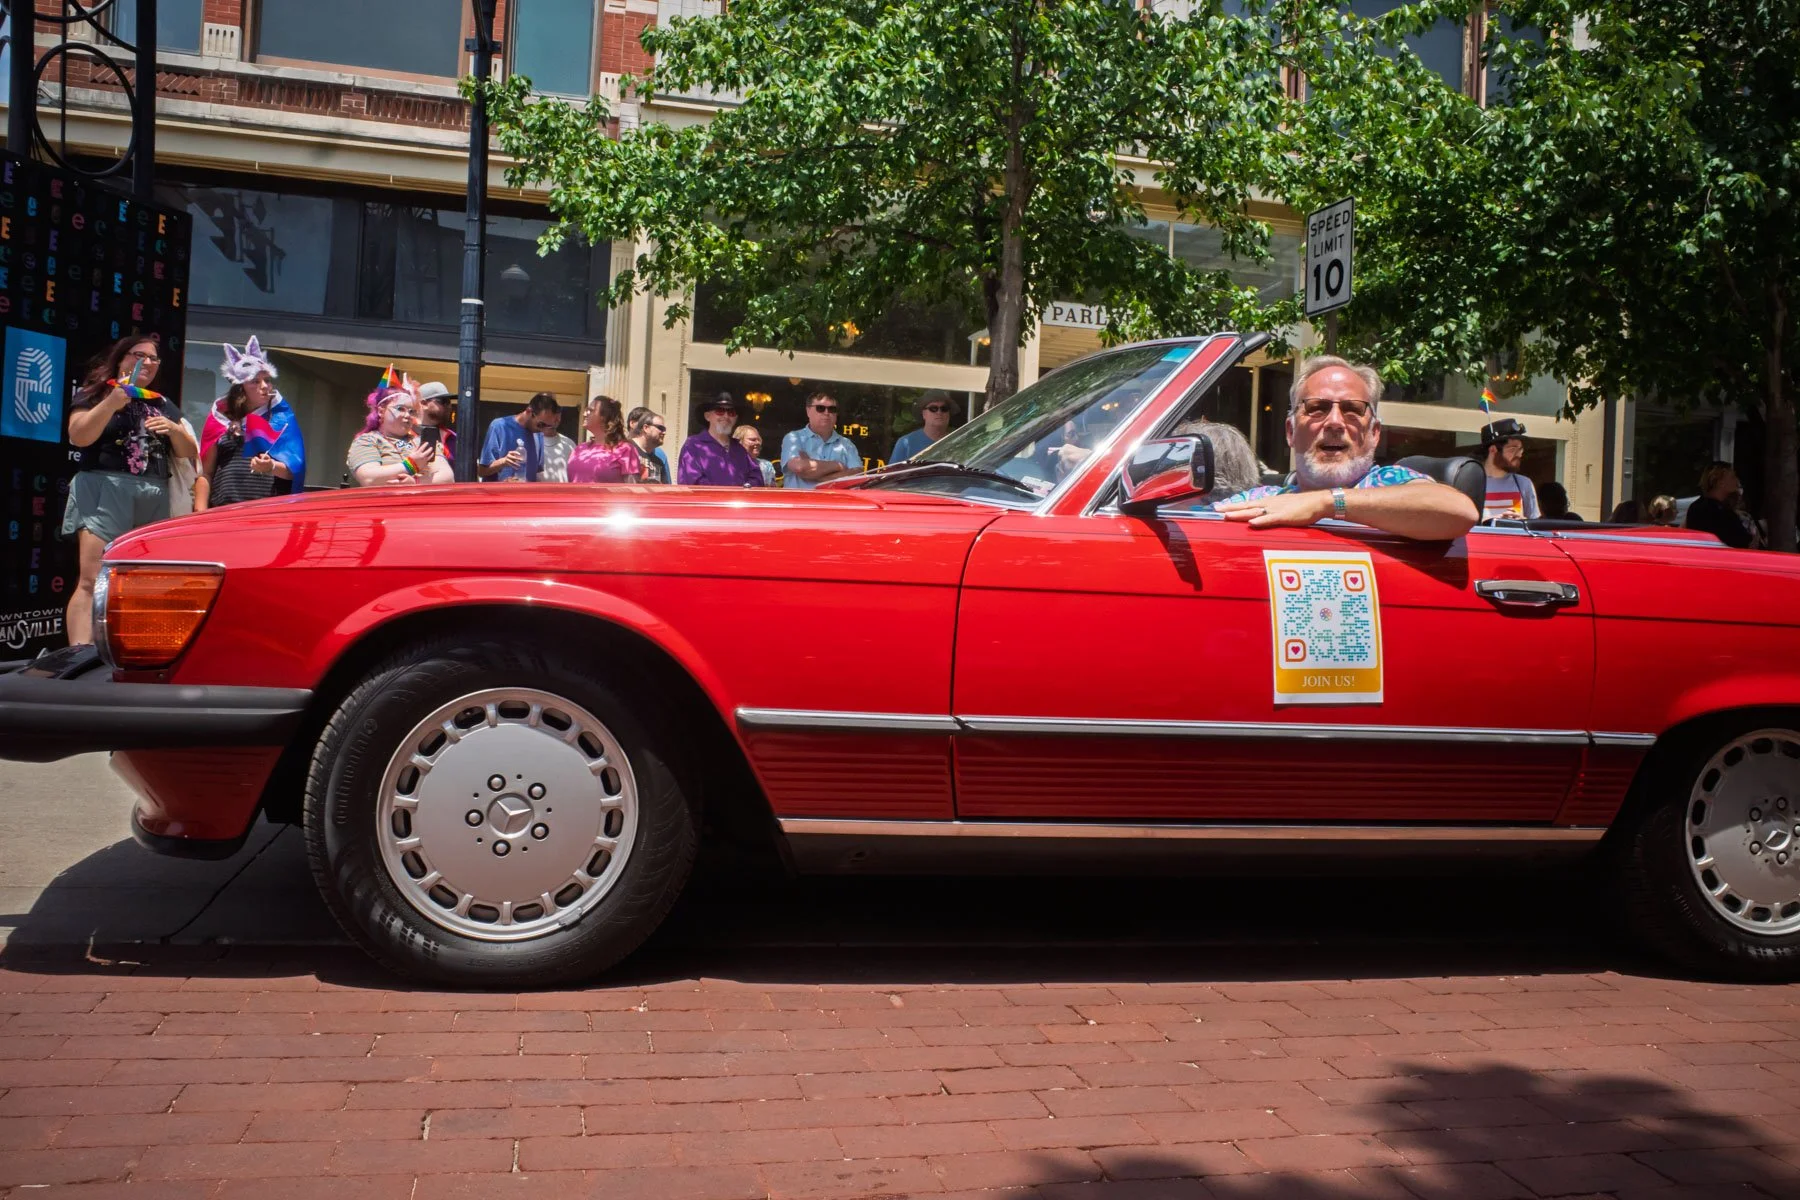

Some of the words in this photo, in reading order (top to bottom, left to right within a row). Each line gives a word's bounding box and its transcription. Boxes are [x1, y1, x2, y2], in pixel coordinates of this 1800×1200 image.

[1310, 210, 1350, 238] SPEED
[1313, 234, 1345, 258] LIMIT
[1313, 258, 1344, 302] 10
[1051, 306, 1132, 326] PARL
[833, 424, 869, 436] HE
[1301, 675, 1332, 687] JOIN
[1334, 674, 1356, 687] US!
